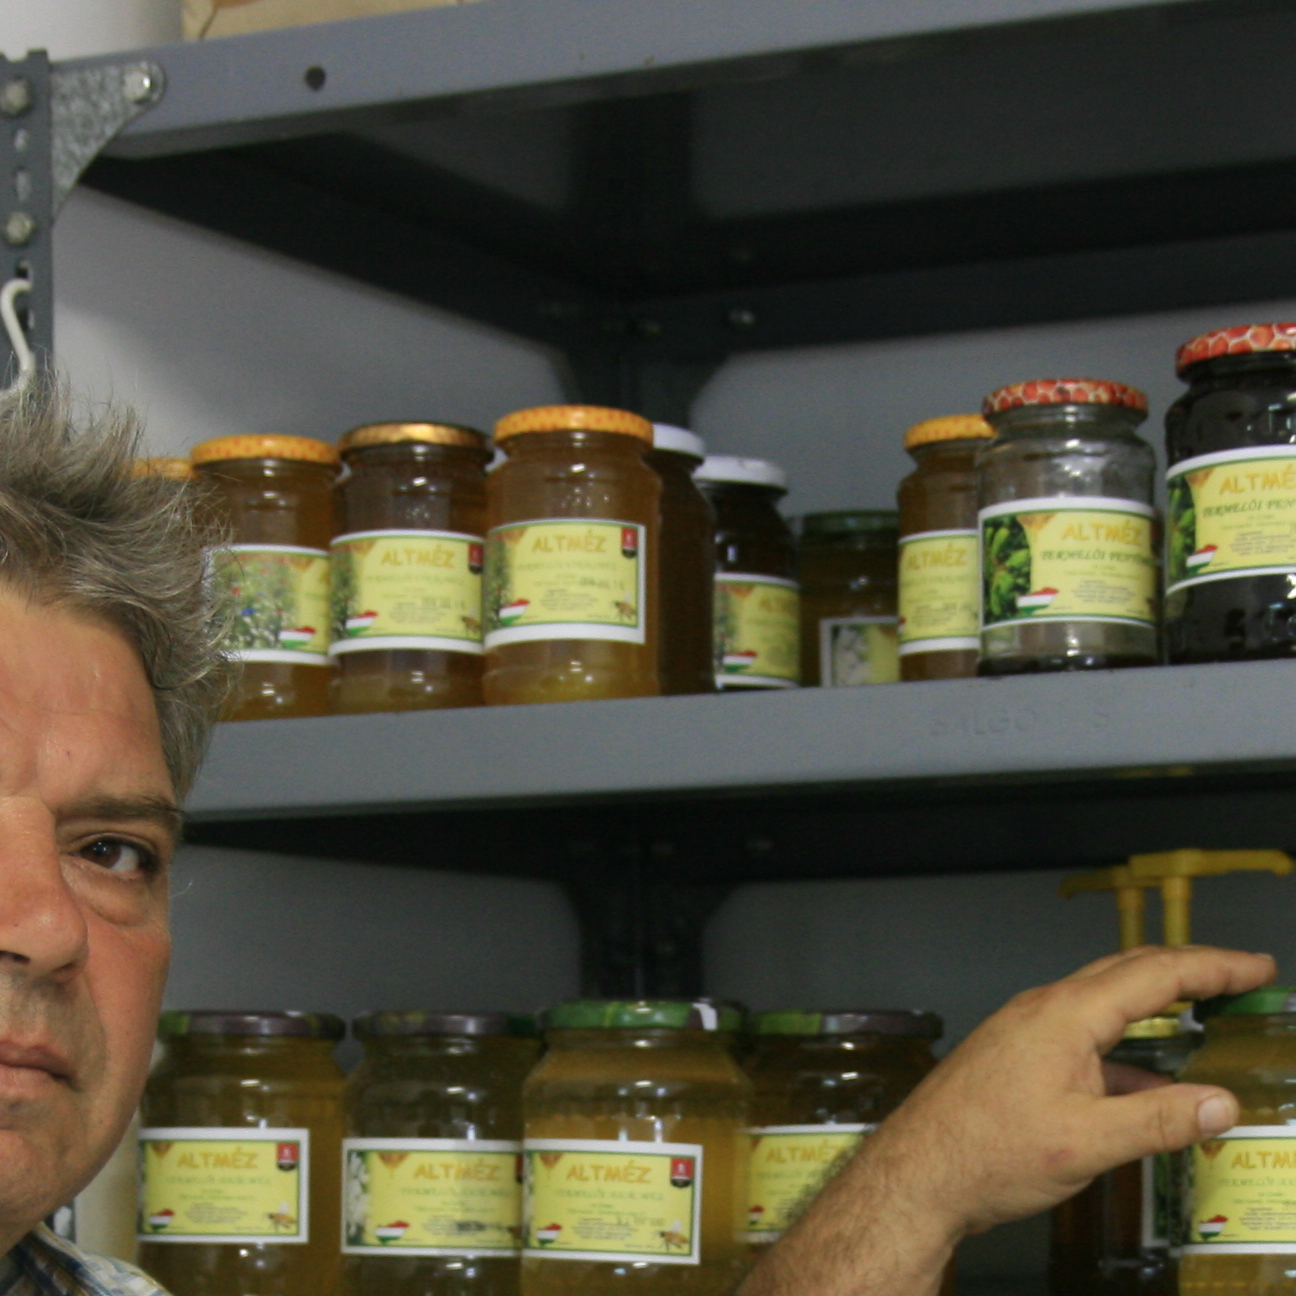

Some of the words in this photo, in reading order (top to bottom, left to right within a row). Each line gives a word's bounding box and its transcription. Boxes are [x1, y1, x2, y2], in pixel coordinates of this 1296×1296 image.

[532, 528, 608, 553] ALTMÉZ
[1060, 519, 1144, 546] ALTMÉZ
[177, 1145, 258, 1170] ALTMÉZ
[413, 1158, 500, 1181] ALTMÉZ
[566, 1159, 653, 1184] ALTMÉZ
